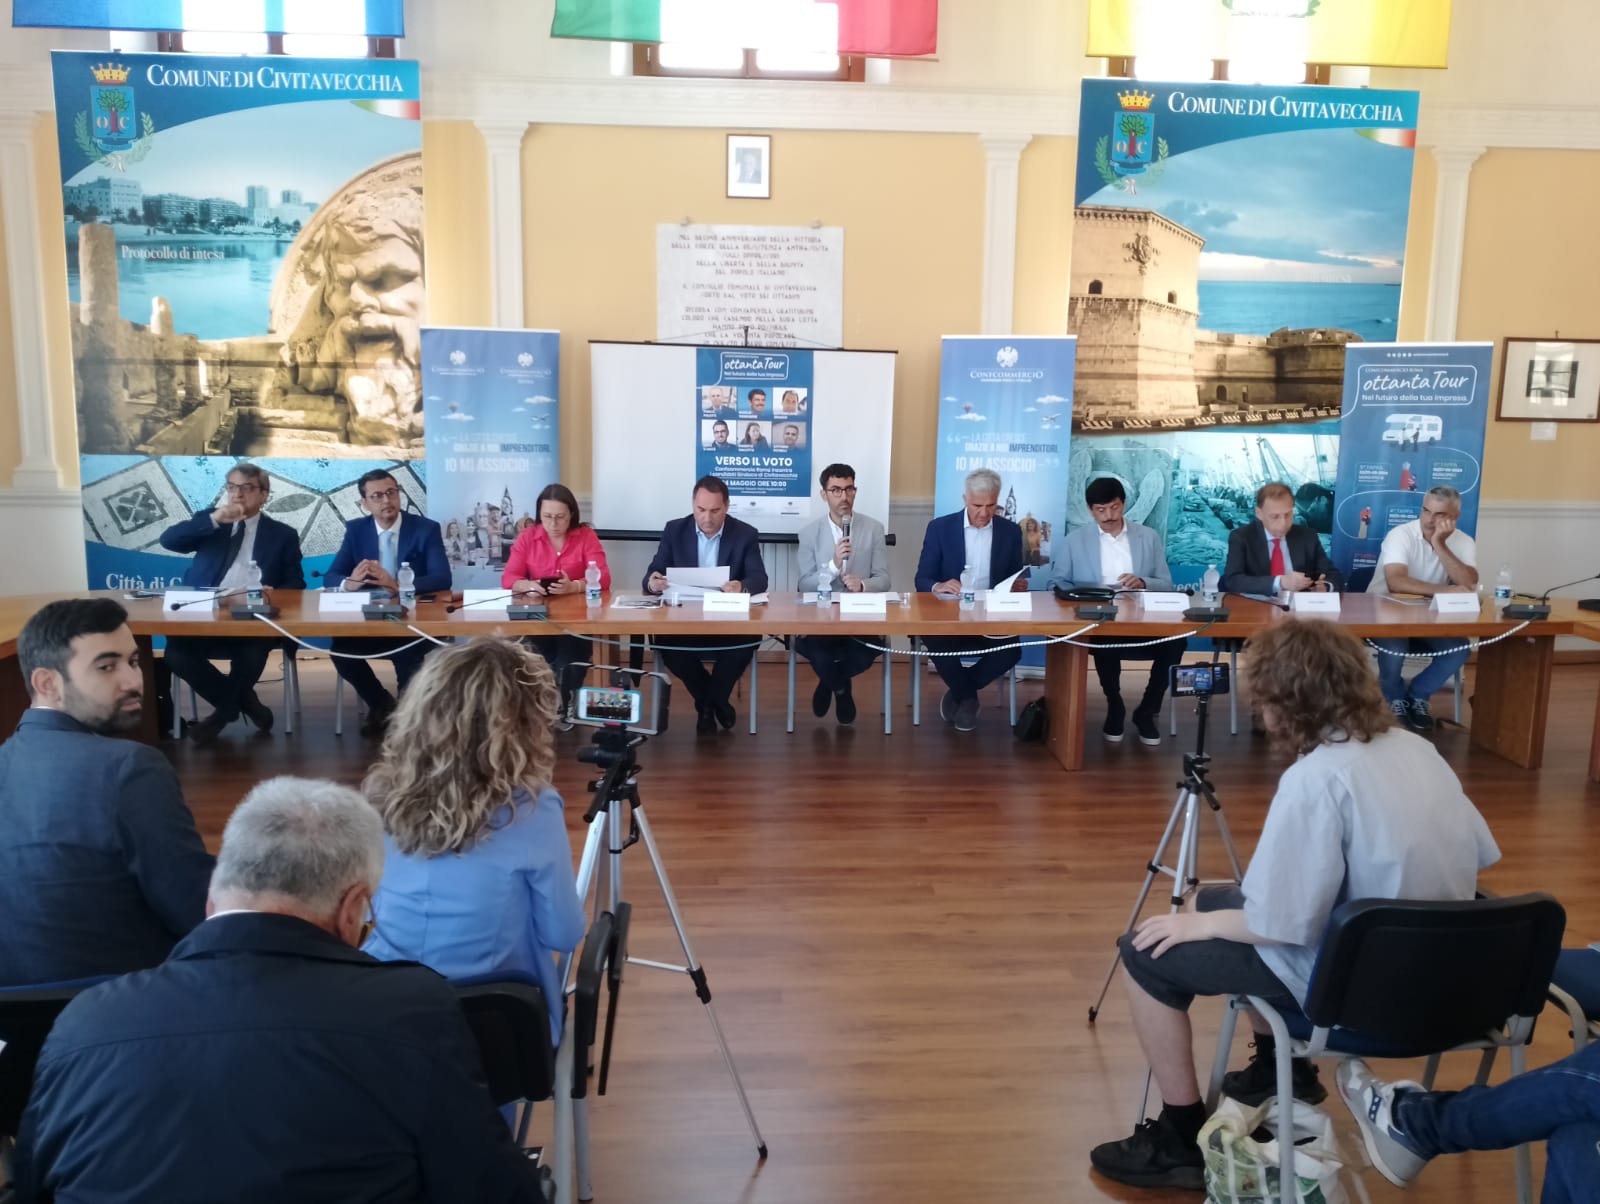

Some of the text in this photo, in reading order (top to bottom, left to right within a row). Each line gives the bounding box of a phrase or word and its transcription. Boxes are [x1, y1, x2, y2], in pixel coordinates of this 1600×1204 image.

[147, 64, 403, 92] COMUNE DI CIVITAVECCHIA
[1168, 92, 1403, 121] COMUNE DI CIVITAVECCHIA
[121, 245, 224, 260] Protocollo di intesa
[445, 457, 457, 472] IO
[715, 456, 792, 466] VERSO IL VOTO
[956, 456, 967, 472] IO
[106, 573, 144, 590] Città
[149, 577, 164, 590] di
